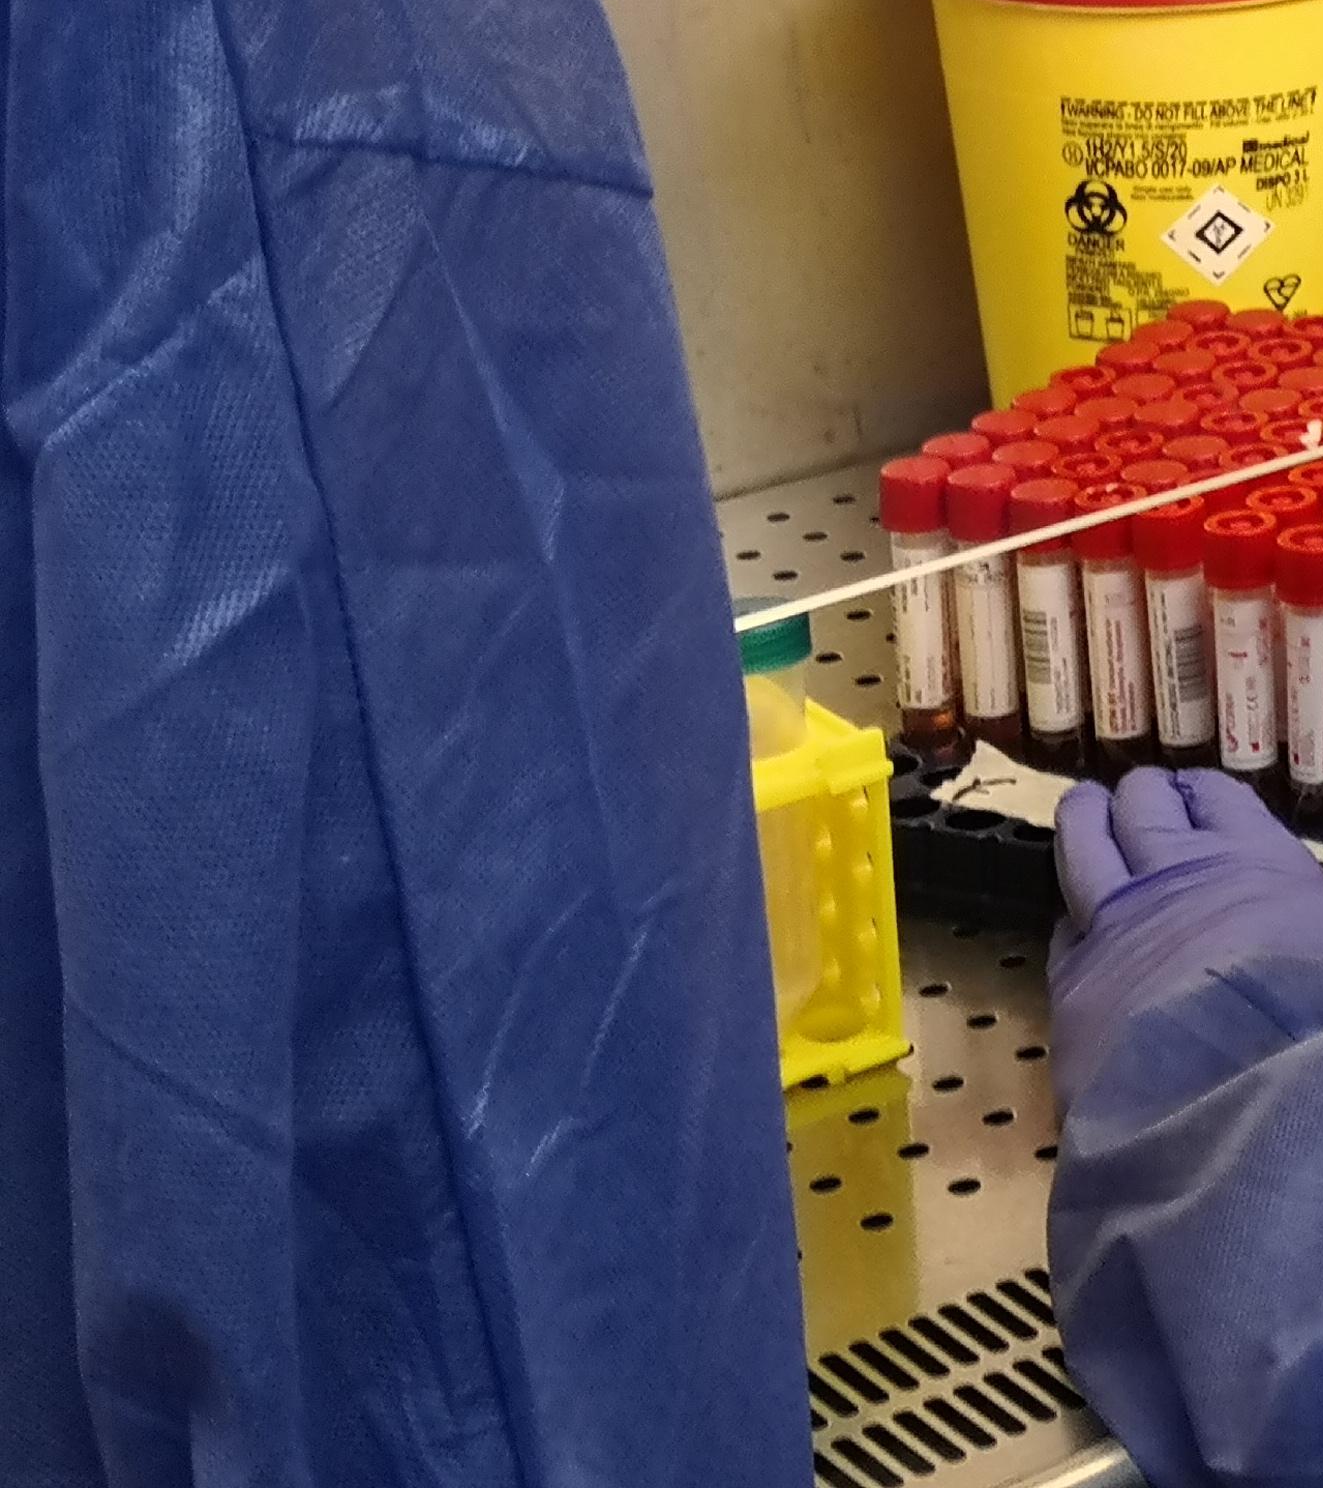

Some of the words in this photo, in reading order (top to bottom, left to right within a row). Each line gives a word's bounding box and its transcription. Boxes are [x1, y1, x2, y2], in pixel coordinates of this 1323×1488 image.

[1134, 104, 1153, 121] DO
[1156, 103, 1182, 121] NOT
[1184, 103, 1208, 121] FILL
[1209, 100, 1250, 119] ABOVE
[1240, 145, 1310, 174] MEDICAL
